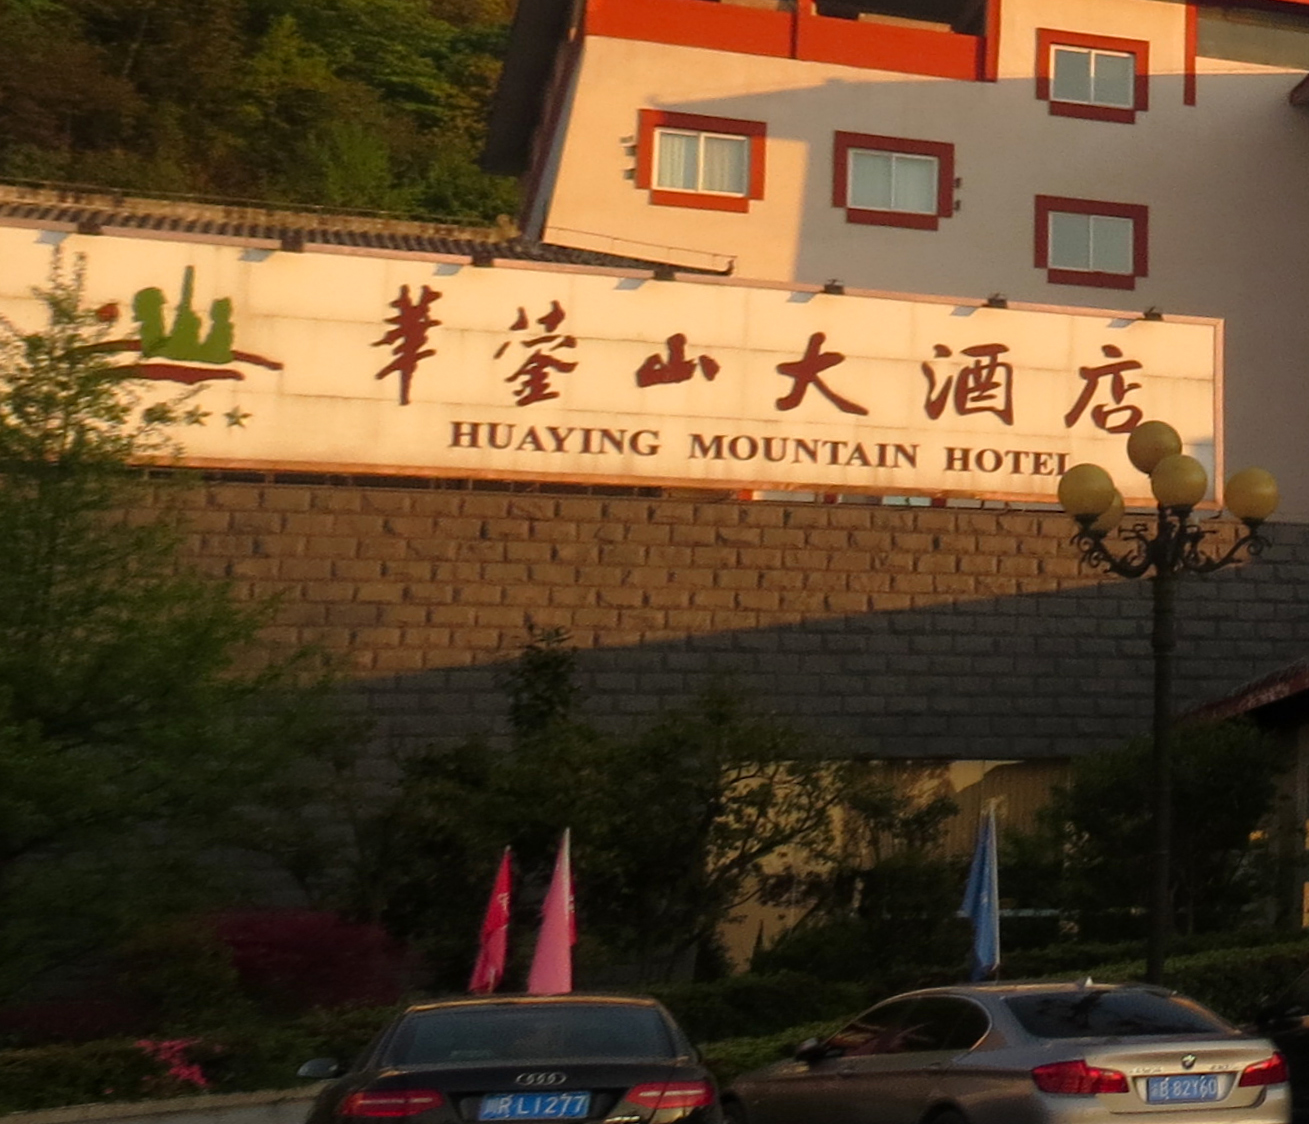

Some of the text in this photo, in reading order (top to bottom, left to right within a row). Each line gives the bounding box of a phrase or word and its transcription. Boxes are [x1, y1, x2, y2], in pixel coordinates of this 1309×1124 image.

[450, 421, 1070, 476] HUAYING MOUNTAIN HOTEL
